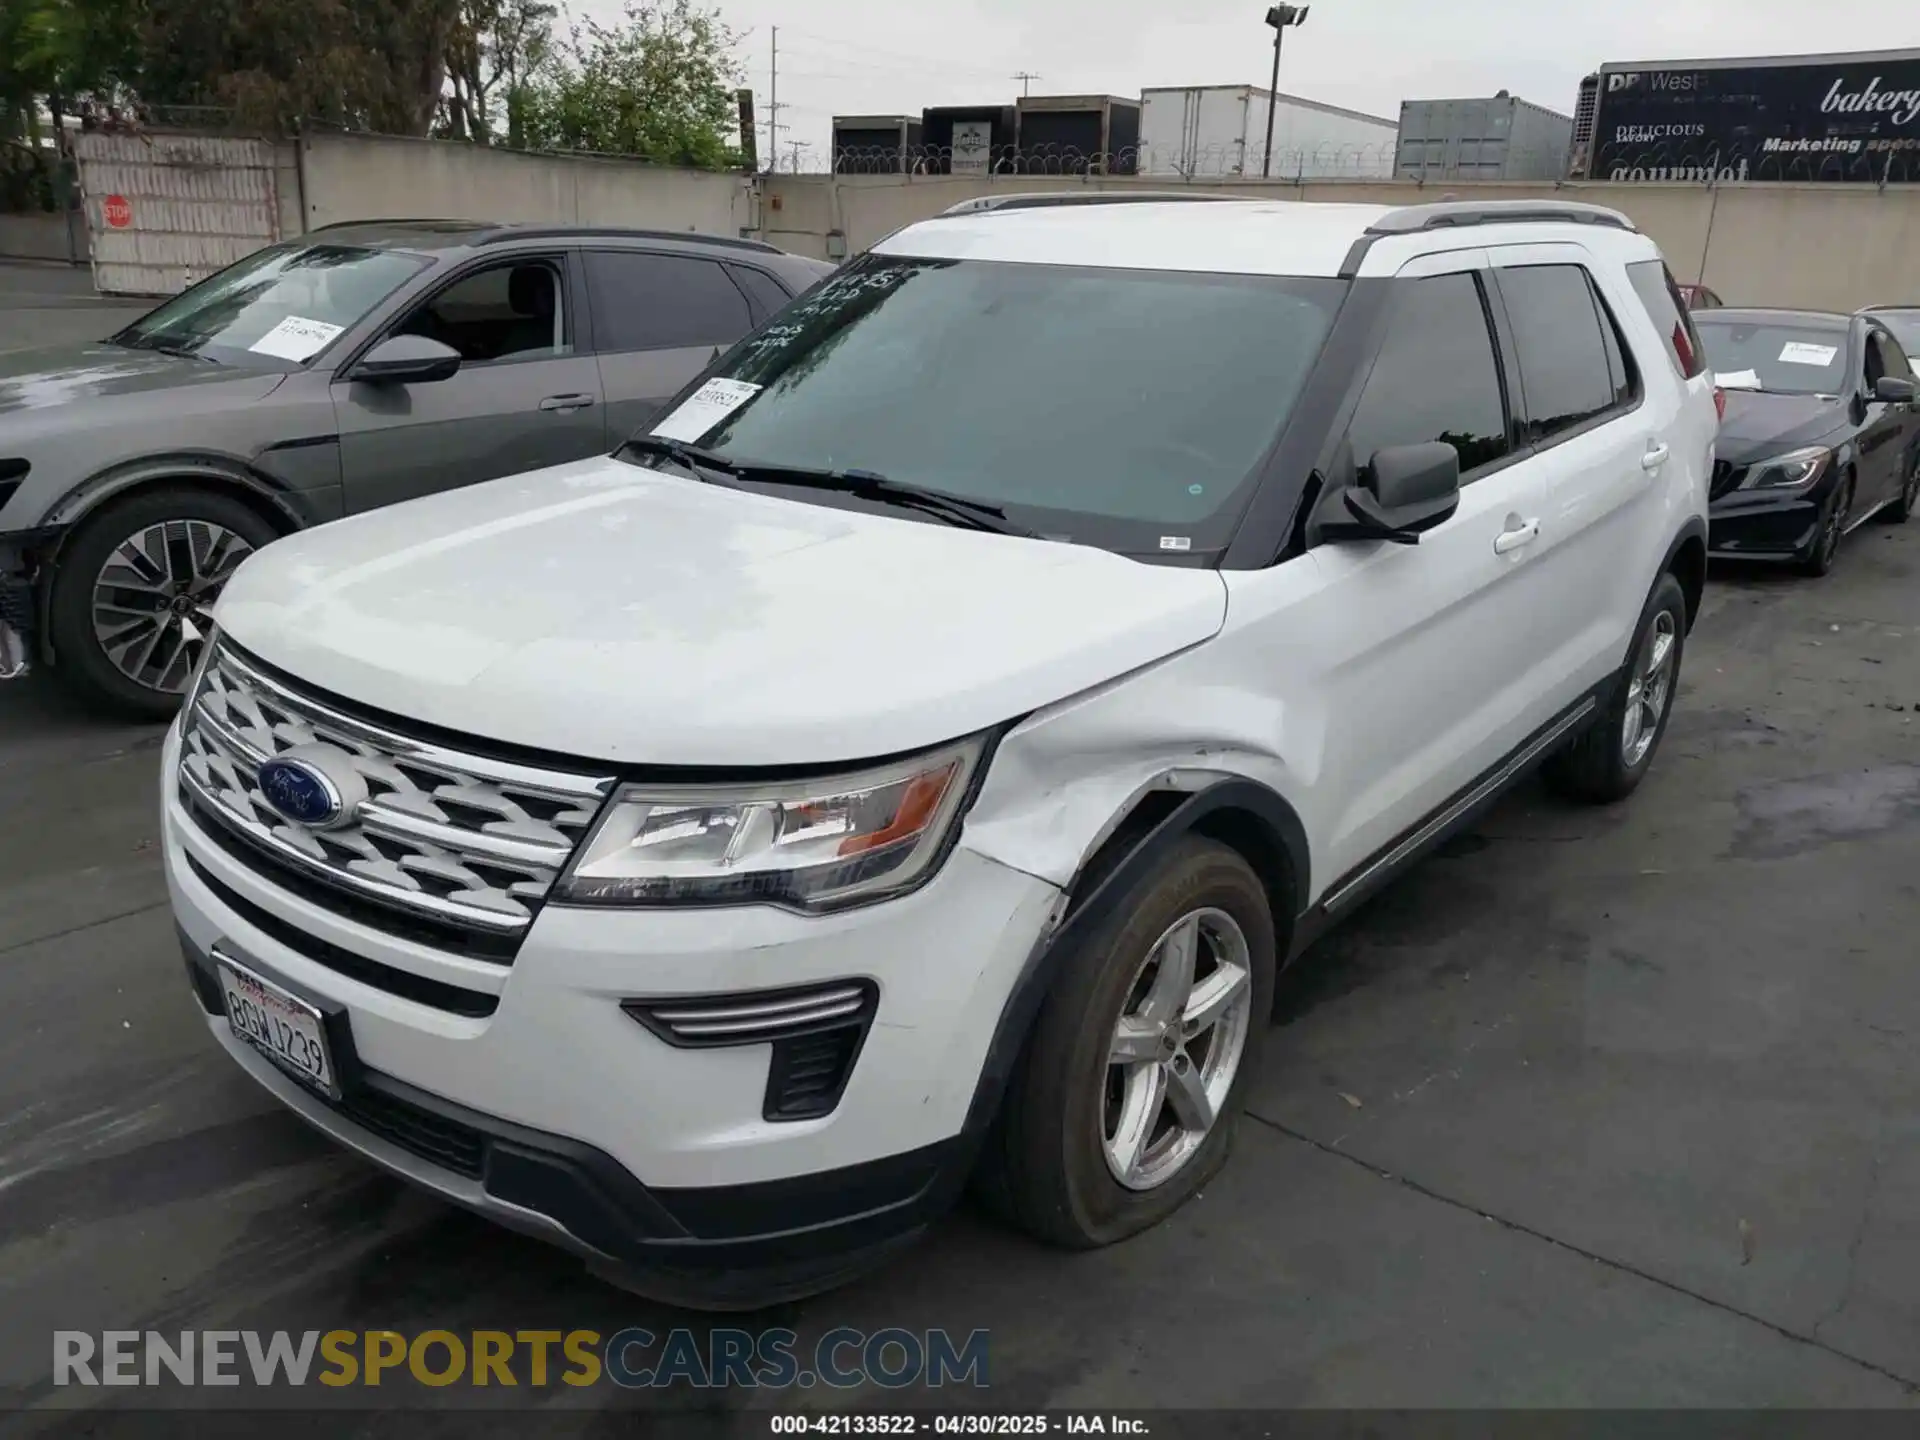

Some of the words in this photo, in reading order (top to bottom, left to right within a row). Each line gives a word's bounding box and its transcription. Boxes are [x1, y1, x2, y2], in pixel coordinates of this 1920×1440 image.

[1820, 76, 1920, 125] bakery
[1616, 124, 1705, 137] DELICIOUS
[1616, 133, 1655, 143] SAVORY
[1763, 137, 1862, 153] Marketing
[104, 204, 130, 219] STOP
[228, 991, 323, 1075] 8GWJ239
